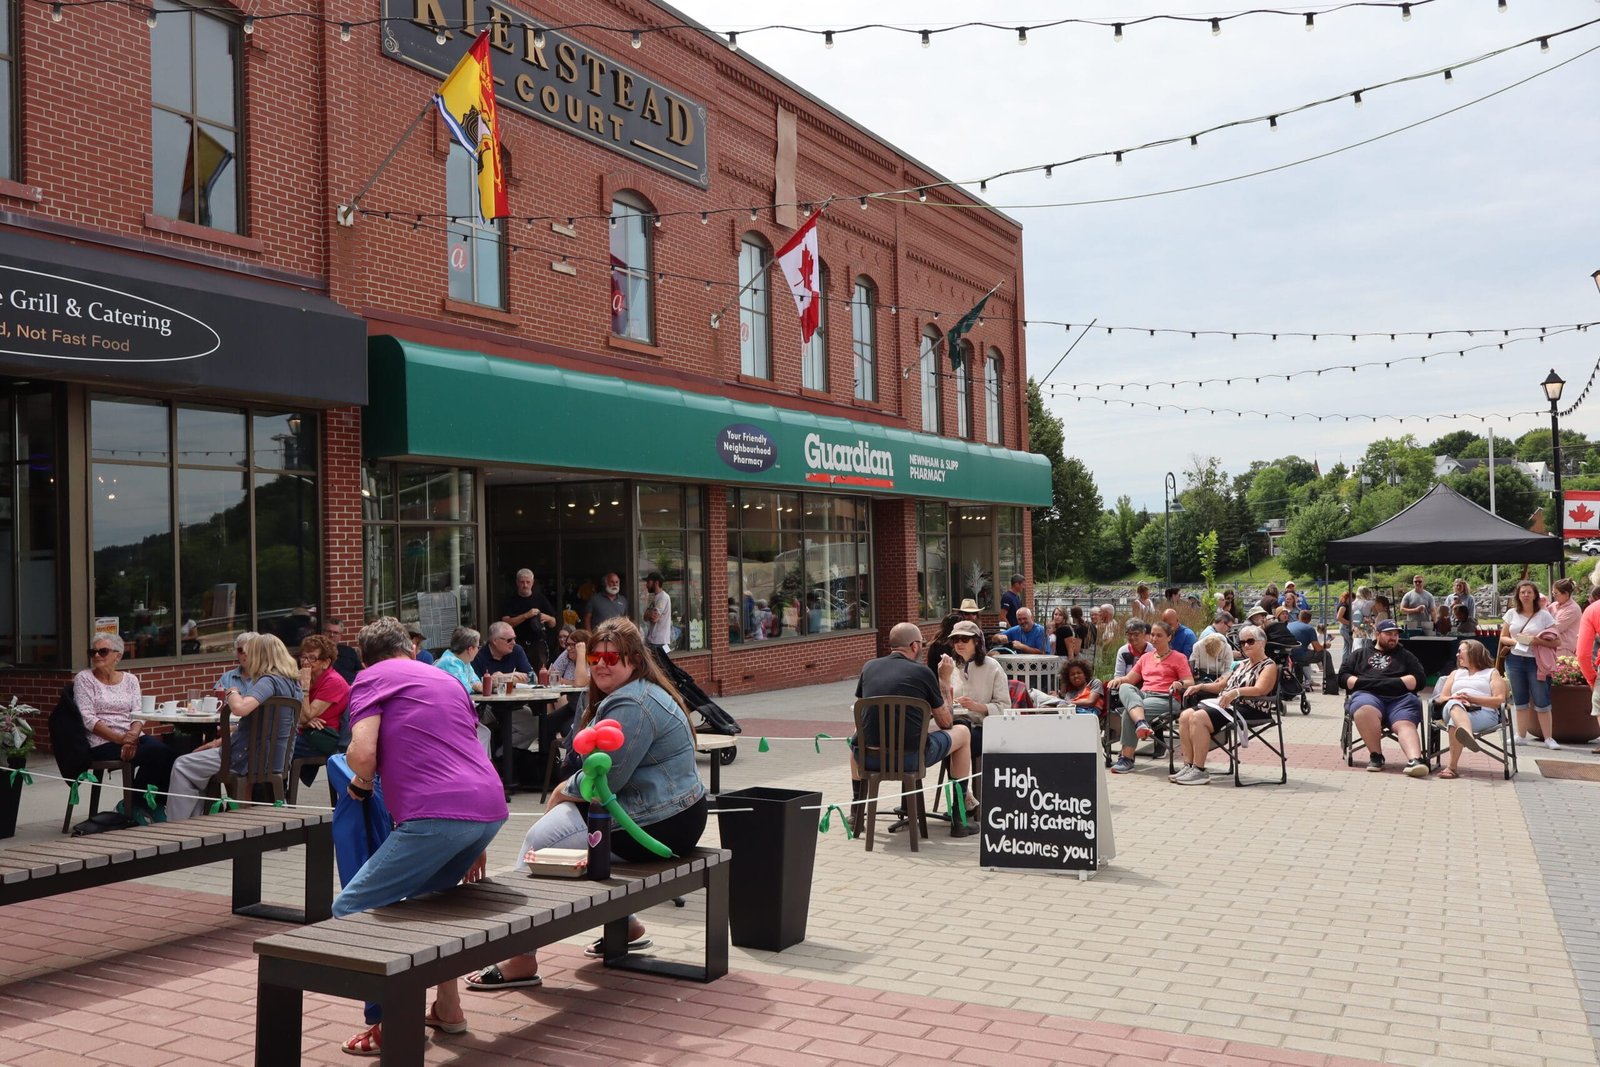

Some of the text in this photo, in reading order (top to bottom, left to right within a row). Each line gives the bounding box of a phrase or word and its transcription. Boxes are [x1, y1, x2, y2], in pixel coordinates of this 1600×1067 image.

[516, 73, 625, 140] COURT
[10, 289, 59, 314] Grill
[65, 298, 82, 318] &
[88, 302, 172, 337] Catering
[16, 324, 47, 341] Not
[52, 329, 87, 346] Fast
[91, 335, 130, 352] Food
[724, 442, 771, 455] Neighbourhood
[727, 430, 767, 445] Your Friendly
[734, 455, 763, 467] Pharmacy
[804, 433, 894, 477] Guardian
[909, 454, 939, 468] NEWNHAM
[909, 466, 946, 483] PHARMACY
[994, 767, 1039, 798] High
[988, 807, 1028, 831] Grill
[1062, 845, 1094, 865] you!
